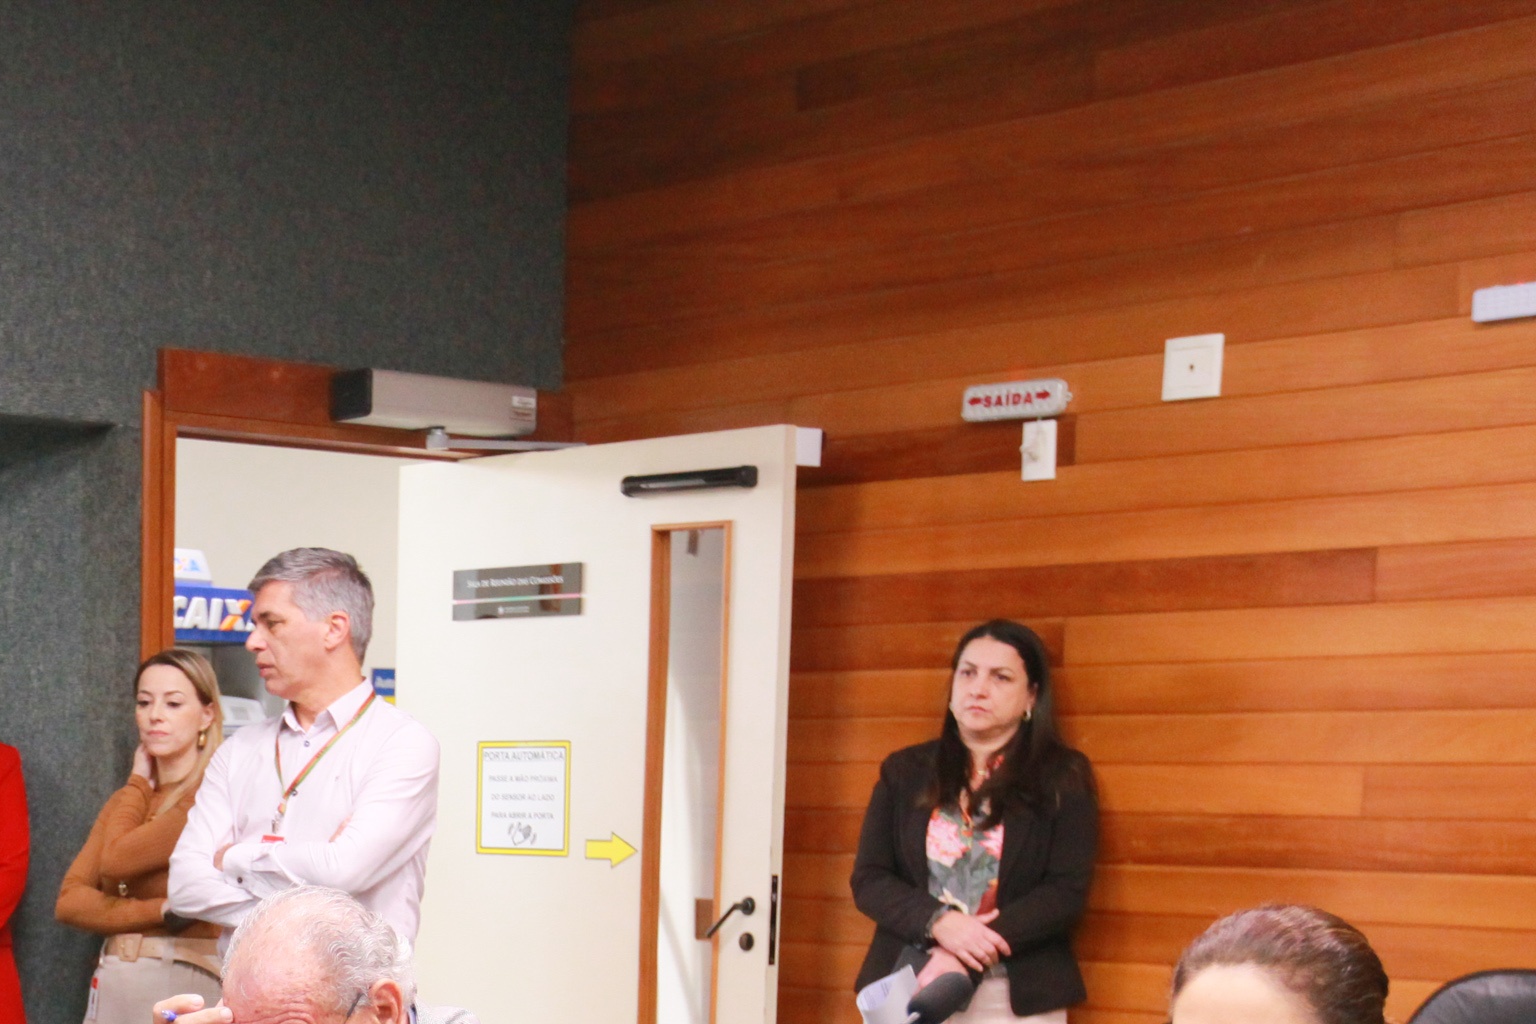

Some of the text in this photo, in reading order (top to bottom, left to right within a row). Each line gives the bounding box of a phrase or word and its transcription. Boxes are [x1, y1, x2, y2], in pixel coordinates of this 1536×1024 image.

[983, 390, 1033, 407] SAÍDA
[173, 595, 256, 631] CAIX
[484, 750, 564, 761] PORTA AUTOMÁTICA
